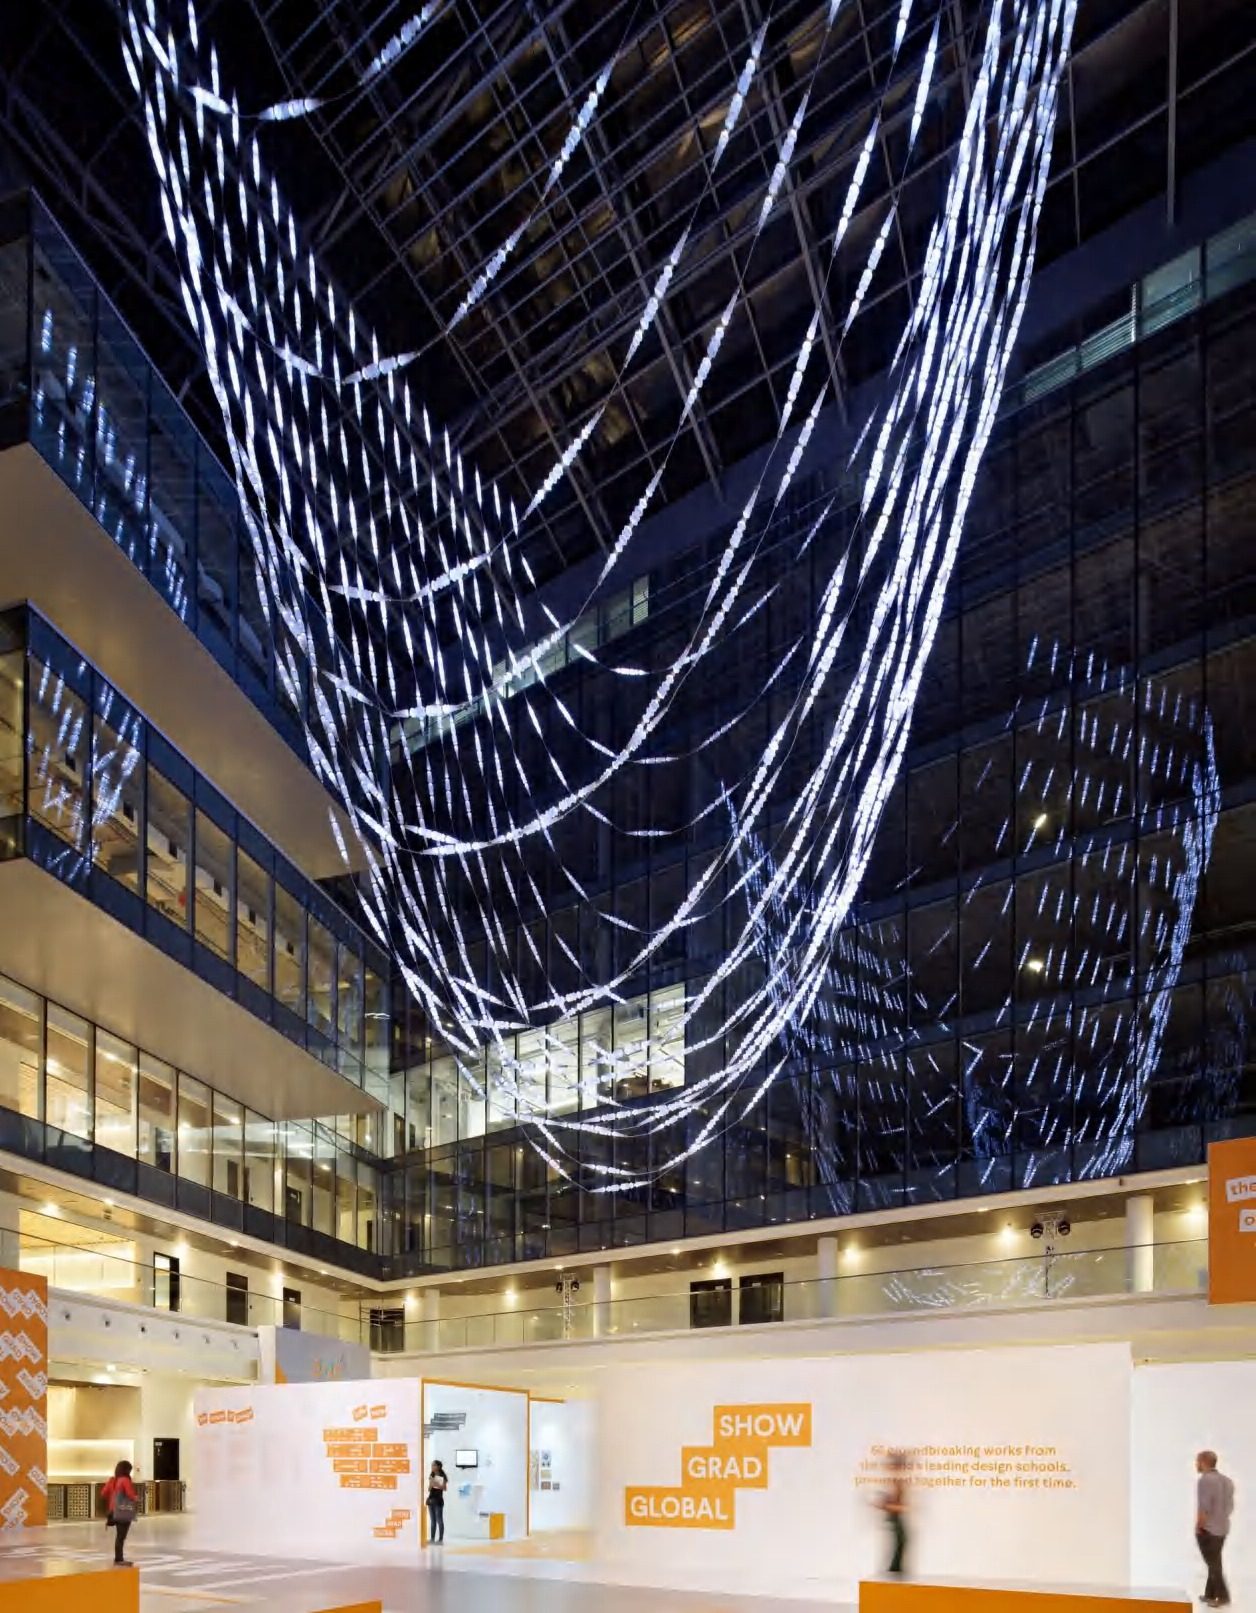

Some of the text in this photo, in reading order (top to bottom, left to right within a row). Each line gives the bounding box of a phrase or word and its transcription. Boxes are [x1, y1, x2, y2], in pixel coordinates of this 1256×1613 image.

[719, 1413, 804, 1437] SHOW
[984, 1445, 1022, 1456] works
[1025, 1444, 1056, 1456] from
[687, 1456, 762, 1479] GRAD
[924, 1459, 969, 1473] leading
[971, 1460, 1013, 1474] design
[969, 1475, 987, 1487] for
[991, 1475, 1010, 1487] the
[1014, 1475, 1040, 1488] first
[631, 1495, 728, 1520] GLOBAL
